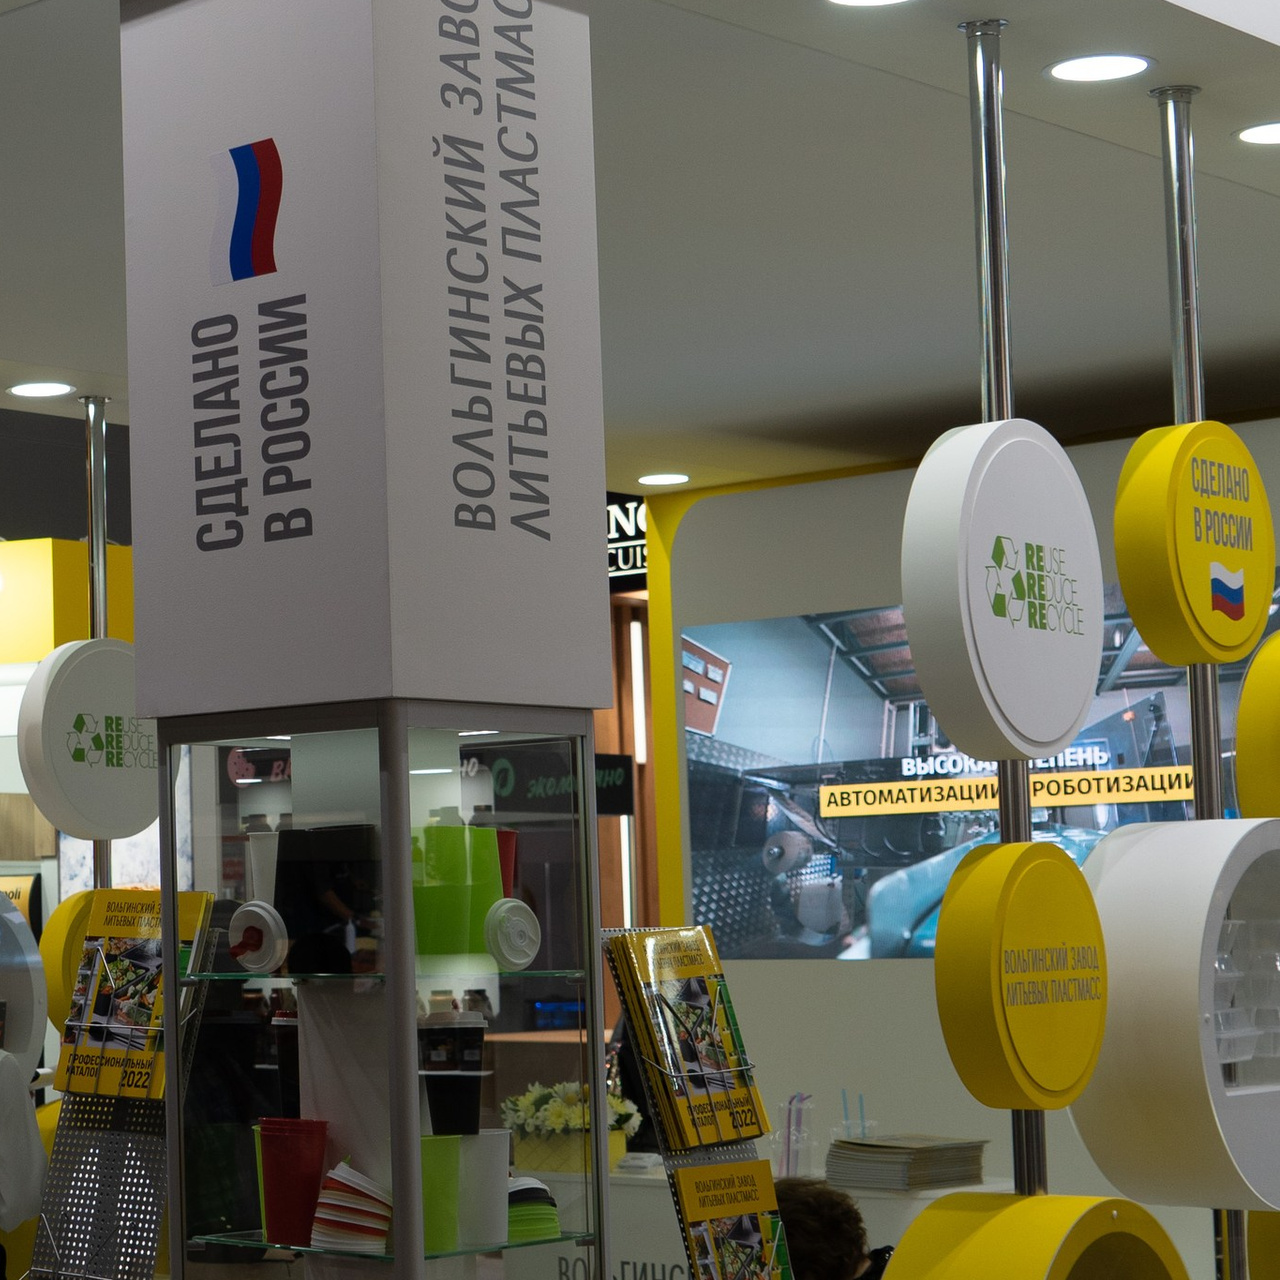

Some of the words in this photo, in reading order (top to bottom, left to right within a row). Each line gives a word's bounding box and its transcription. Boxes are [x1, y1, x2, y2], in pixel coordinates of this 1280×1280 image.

[431, 133, 496, 533] ВОЛЬГИНСКИЙ
[257, 292, 313, 494] РОССИИ
[502, 282, 552, 542] ЛИТЬЕВЫХ
[191, 314, 244, 552] СДЕЛАНО
[1191, 456, 1250, 503] СДЕЛАНО
[263, 515, 313, 543] В
[1193, 506, 1202, 543] В
[1205, 508, 1254, 552] РОССИИ
[1025, 542, 1066, 576] REUSE
[1027, 572, 1077, 607] REDUCE
[1028, 600, 1084, 635] RECYCLE
[105, 732, 154, 751] REDUCE
[106, 901, 154, 915] ВОЛЬГИНСКИЙ
[1004, 942, 1069, 974] ВОЛЬГИНСКИЙ
[1071, 944, 1100, 971] ЗАВОД
[1006, 981, 1049, 1007] ЛИТЬЕВЫХ
[1051, 976, 1102, 1003] ПЛАСТМАСС
[119, 1070, 151, 1089] 2022
[729, 1109, 757, 1129] 2022
[695, 1174, 737, 1194] ВОЛЬГИНСКИЙ
[737, 1174, 757, 1189] ЗАВОД
[698, 1192, 726, 1208] ЛИТЬЕВЫХ
[726, 1189, 760, 1207] ПЛАСТМАСС
